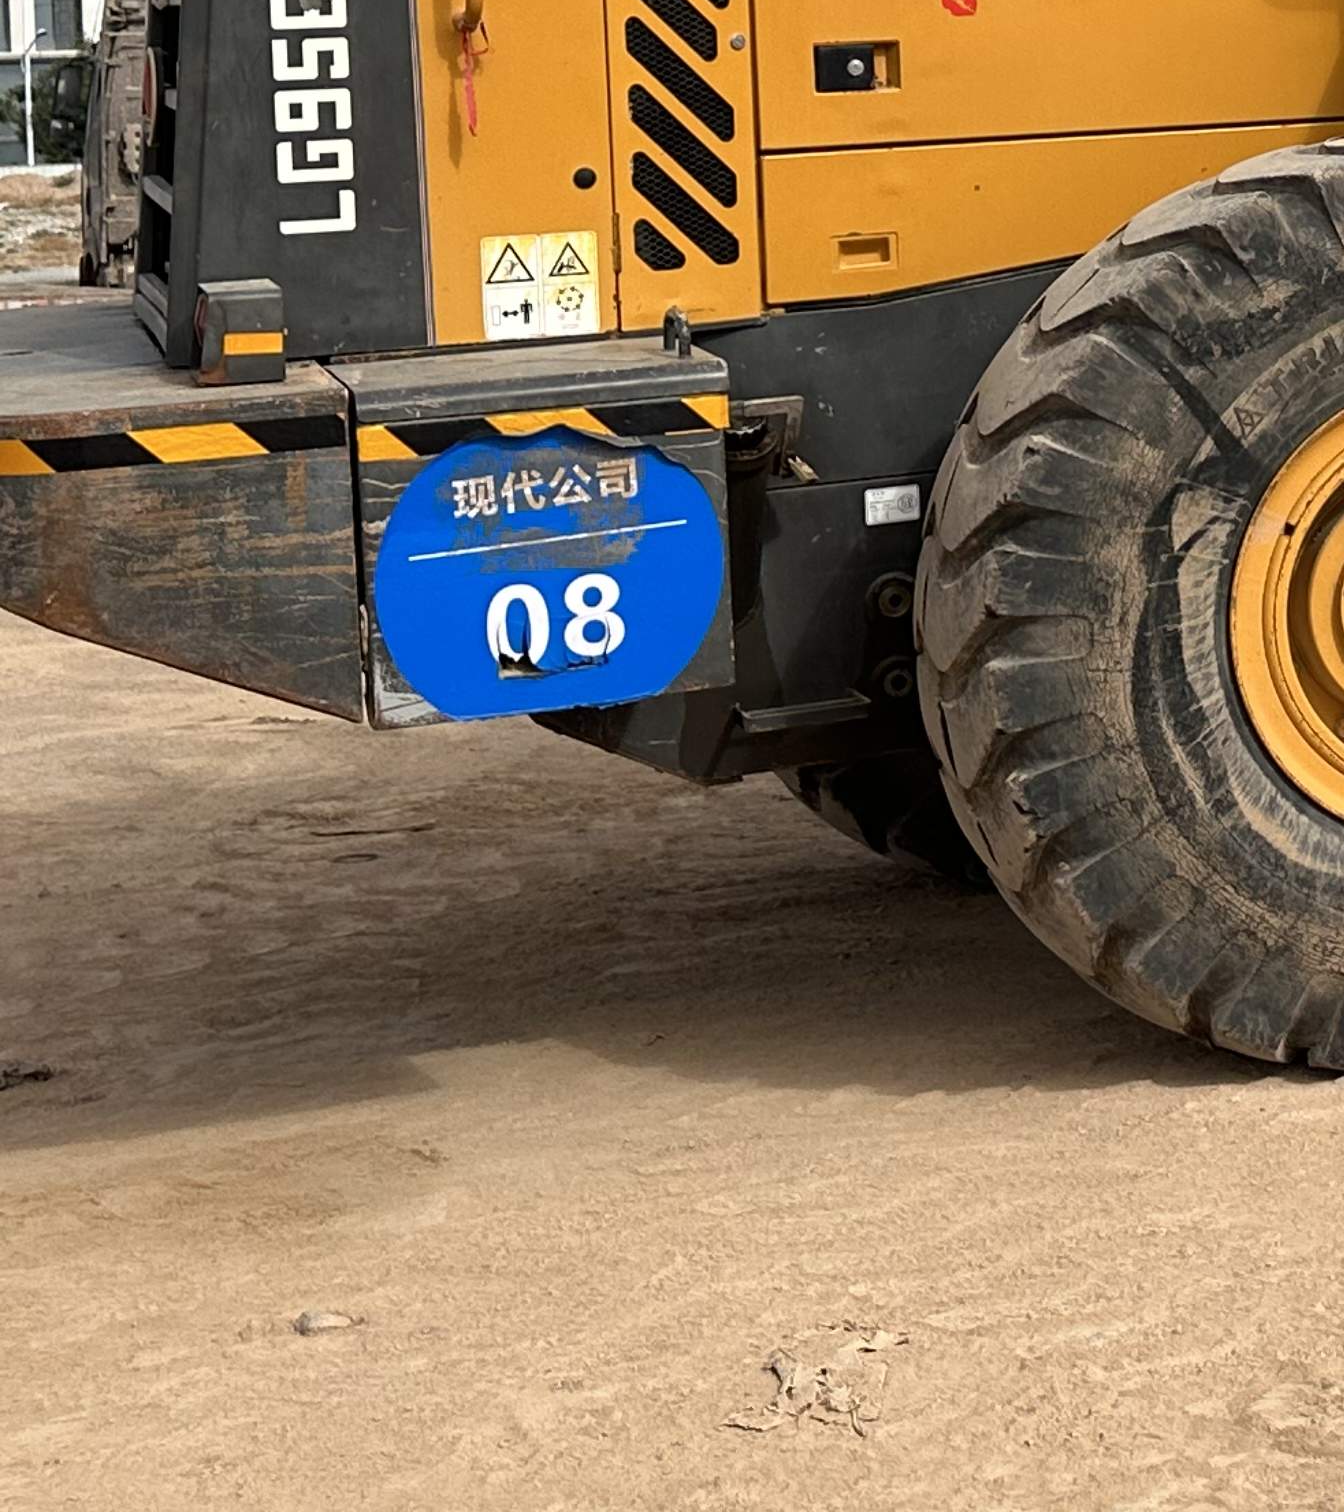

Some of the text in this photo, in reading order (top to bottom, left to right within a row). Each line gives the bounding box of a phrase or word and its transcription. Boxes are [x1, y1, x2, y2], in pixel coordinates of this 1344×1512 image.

[451, 459, 640, 521] 现代公司
[485, 573, 626, 666] 08
